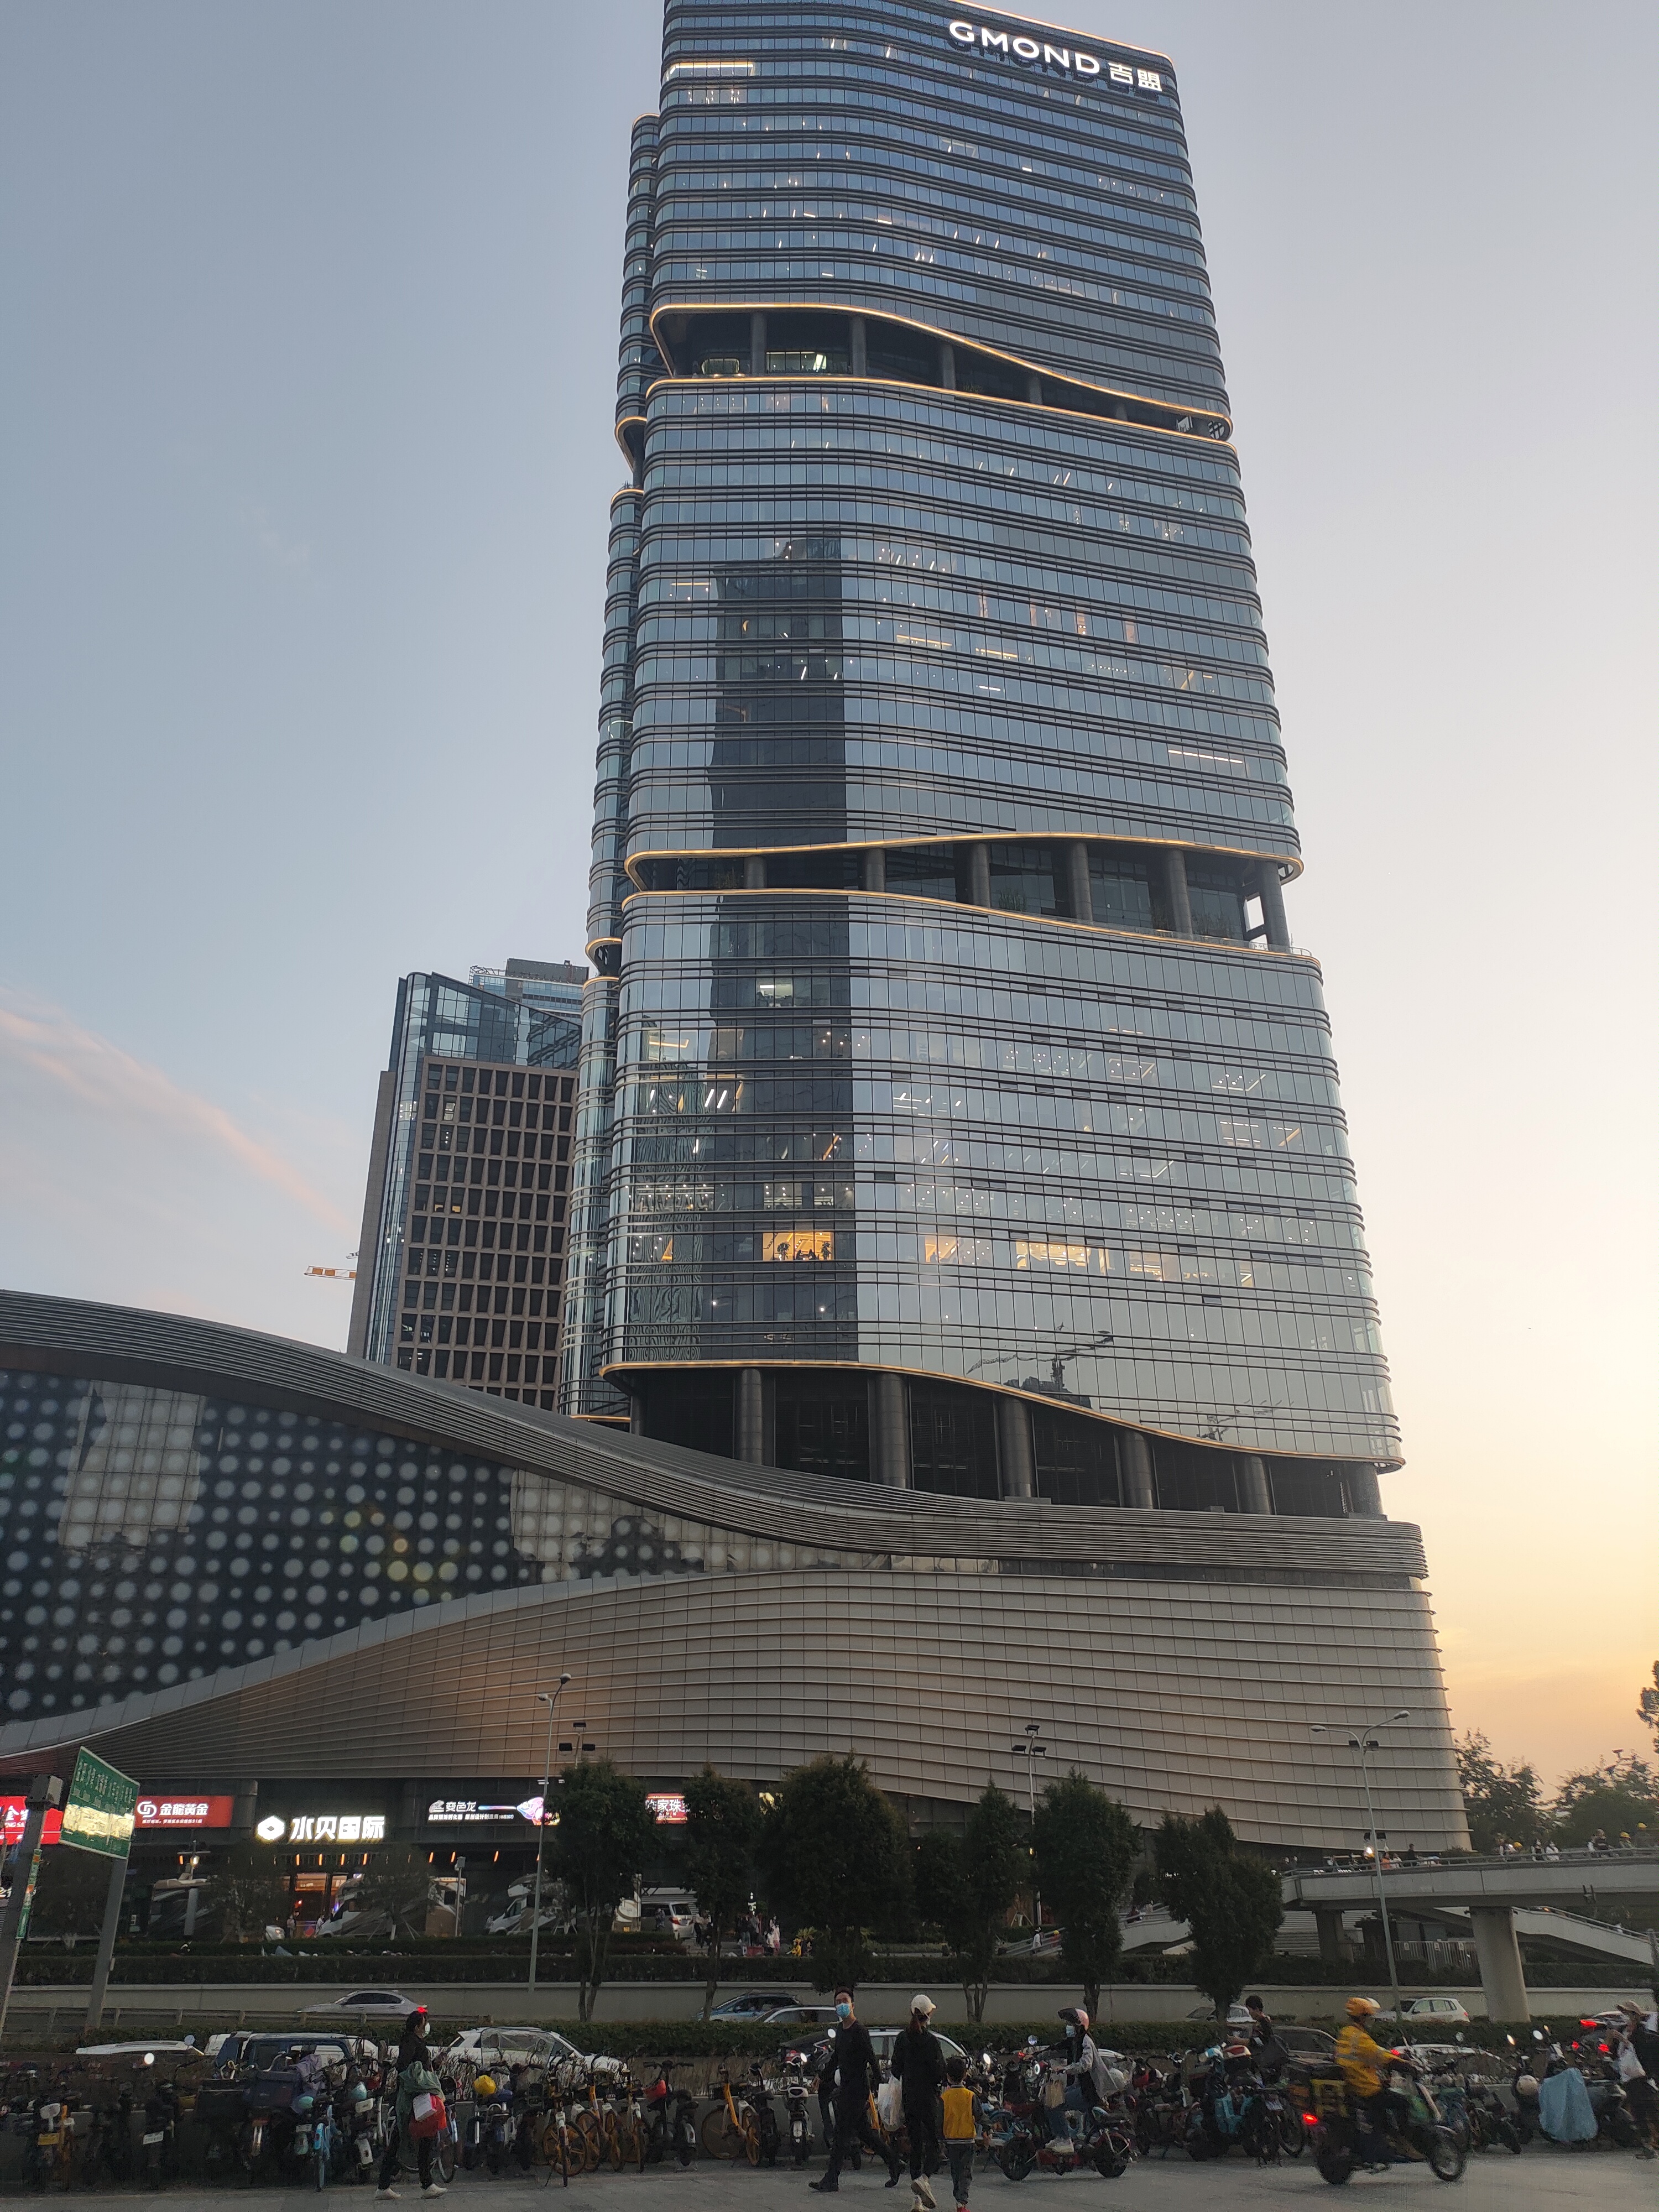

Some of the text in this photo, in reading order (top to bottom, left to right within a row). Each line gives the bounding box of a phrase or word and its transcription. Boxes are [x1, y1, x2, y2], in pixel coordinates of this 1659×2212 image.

[950, 20, 1162, 92] GMOND 吉盟
[445, 1801, 476, 1812] 变色龙
[290, 1815, 385, 1839] 水贝国际
